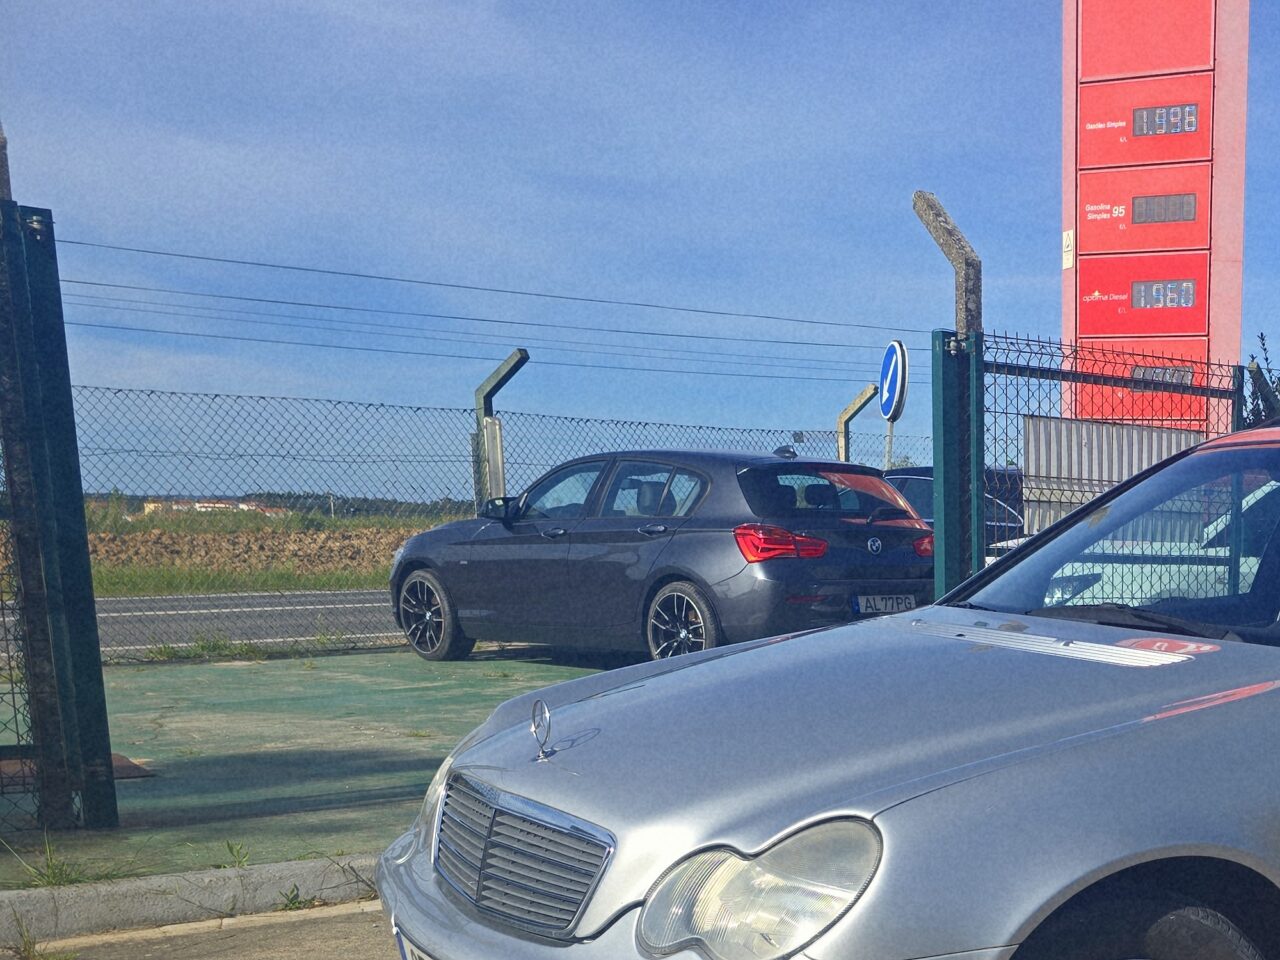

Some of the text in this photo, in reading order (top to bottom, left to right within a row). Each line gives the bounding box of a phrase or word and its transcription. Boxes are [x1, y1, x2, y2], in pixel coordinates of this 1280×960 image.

[1085, 203, 1111, 212] Gasolina
[1112, 205, 1126, 217] 95
[1087, 212, 1111, 220] Simples
[1109, 292, 1129, 301] Diesel
